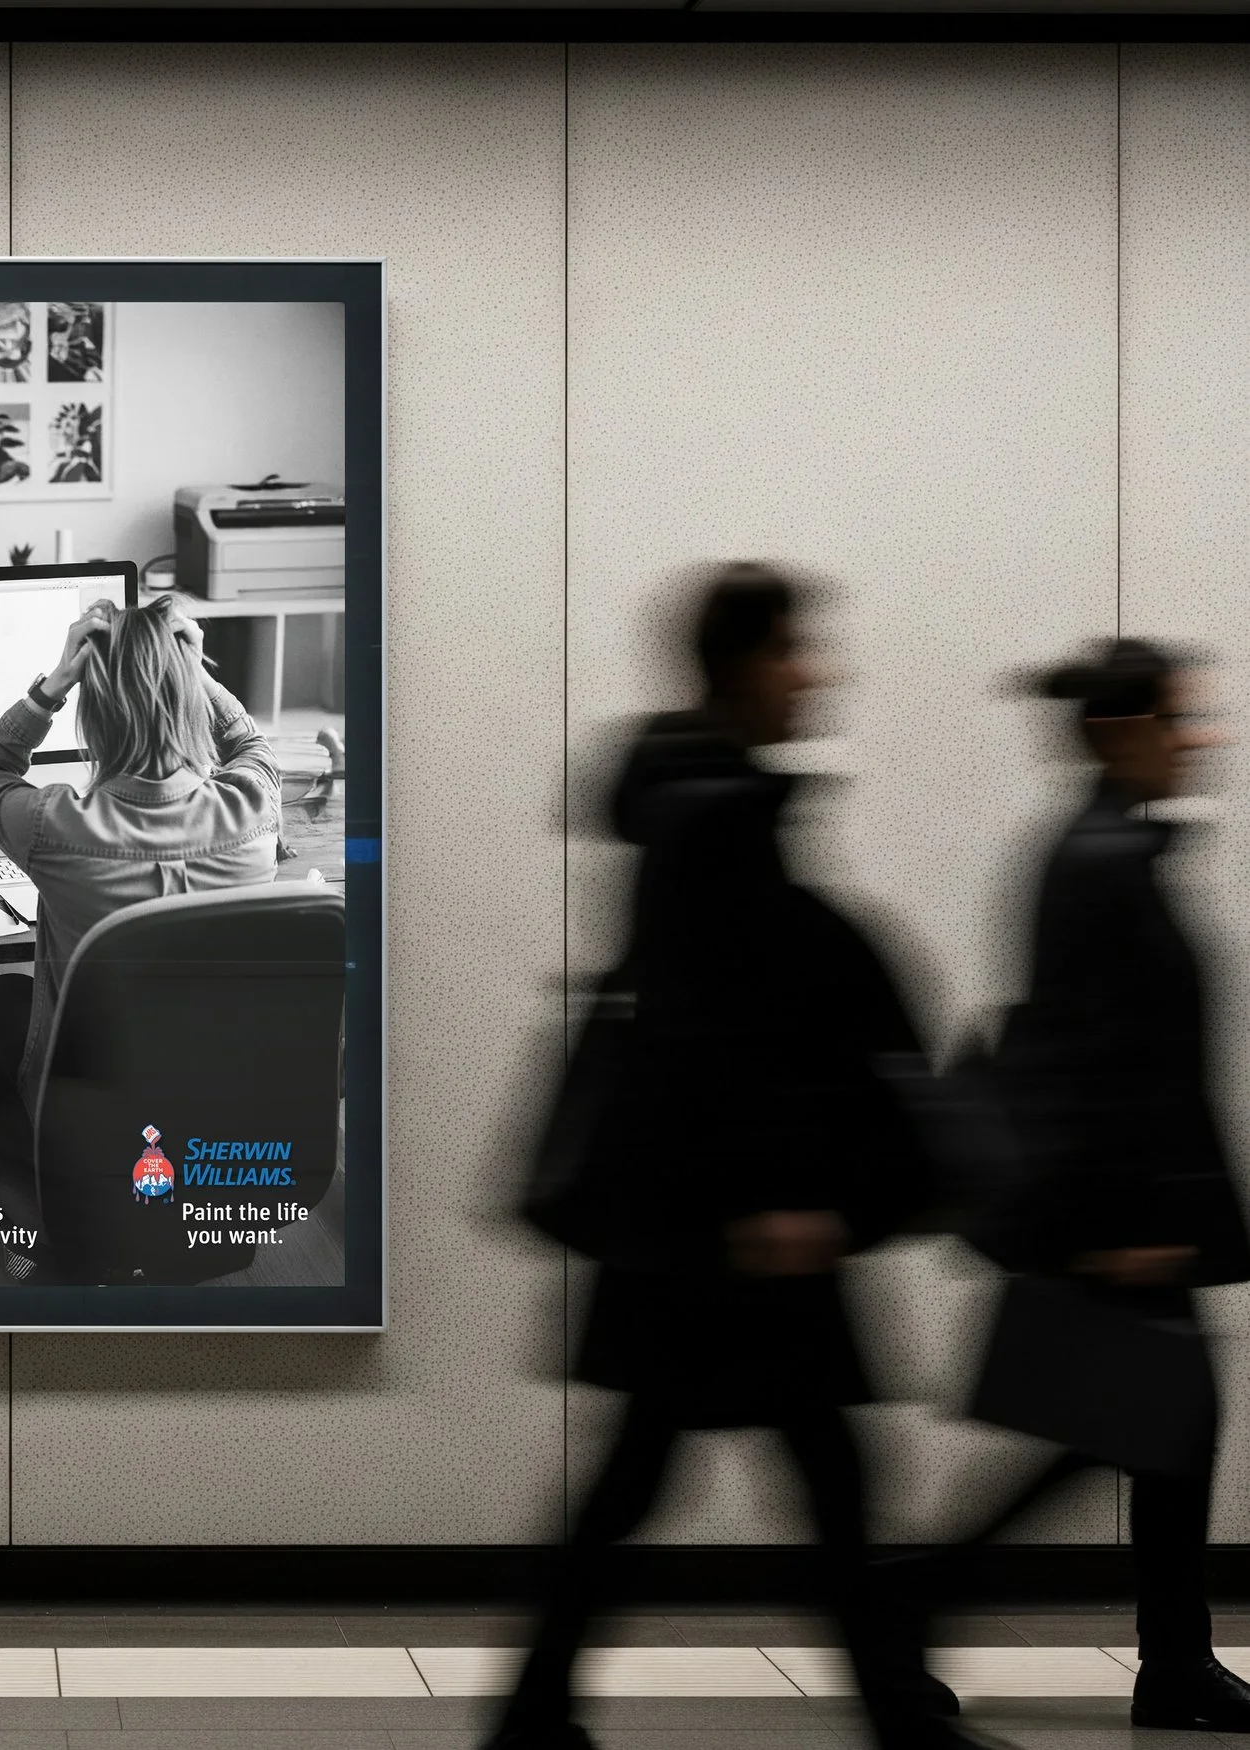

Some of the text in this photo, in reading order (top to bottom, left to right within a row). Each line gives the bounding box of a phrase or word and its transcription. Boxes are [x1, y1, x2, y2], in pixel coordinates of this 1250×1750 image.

[184, 1137, 292, 1161] SHERWIN
[182, 1202, 309, 1221] Paint the life
[187, 1227, 284, 1249] you want.
